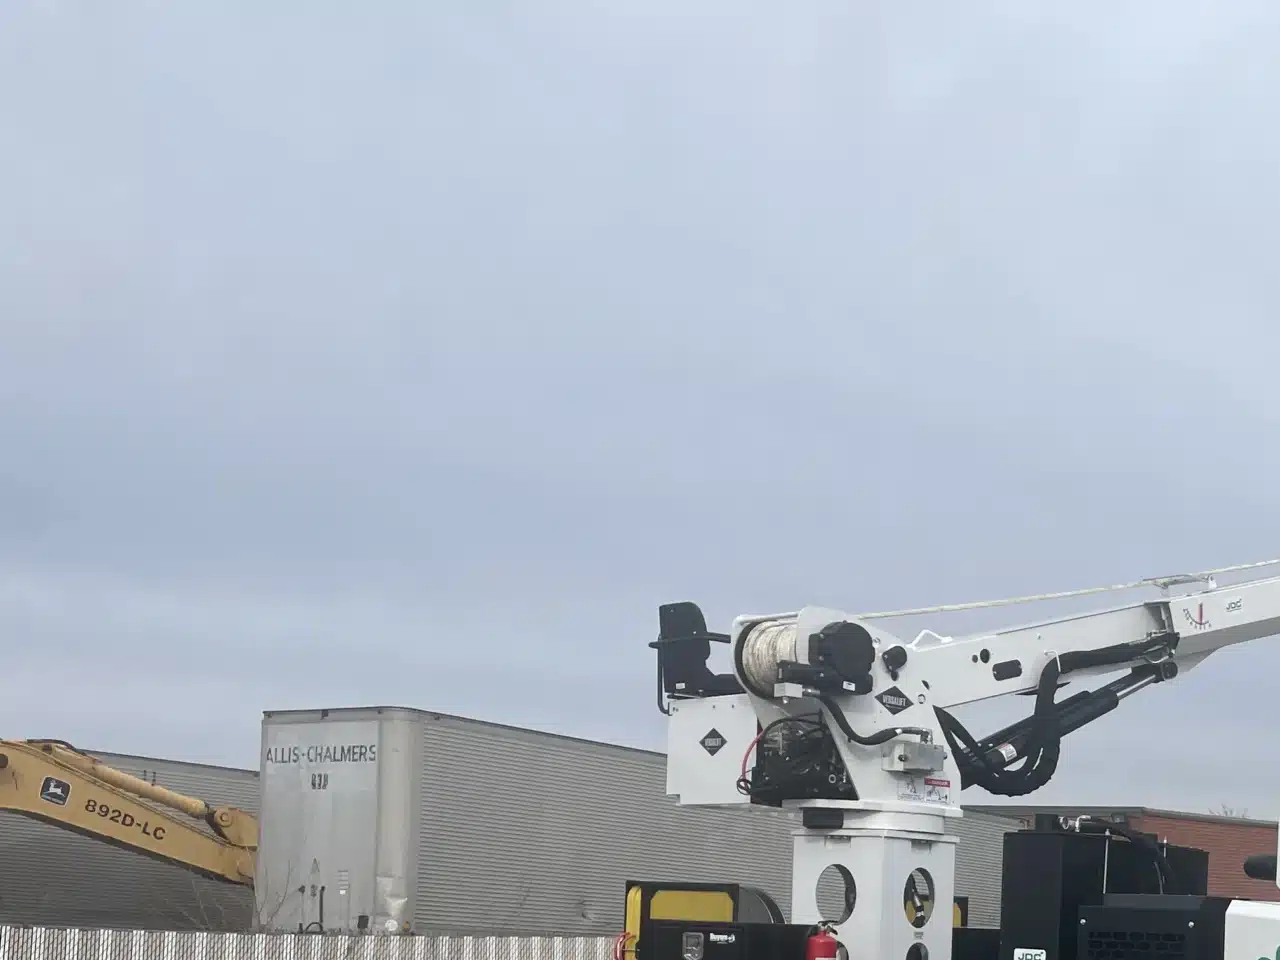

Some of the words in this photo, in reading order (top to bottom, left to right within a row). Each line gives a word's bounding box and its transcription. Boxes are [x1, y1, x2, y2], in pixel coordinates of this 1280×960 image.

[1226, 600, 1242, 610] JDC
[266, 744, 376, 763] ALLIS-CHALMERS
[84, 799, 166, 840] 892D-LC
